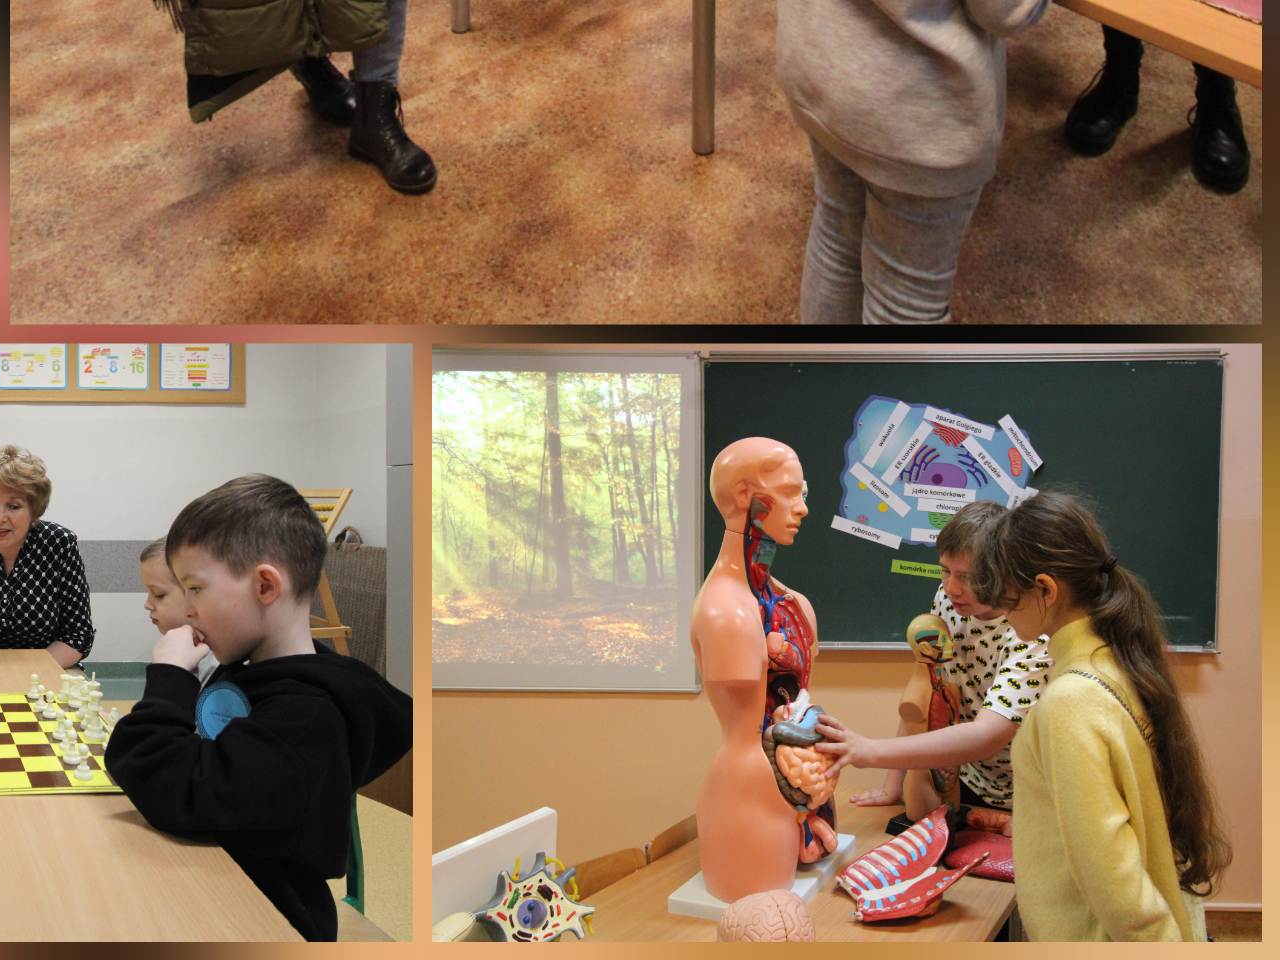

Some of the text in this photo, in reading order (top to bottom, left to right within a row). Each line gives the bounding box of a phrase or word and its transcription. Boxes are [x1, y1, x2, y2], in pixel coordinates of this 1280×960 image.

[1, 359, 10, 372] 8
[26, 359, 35, 372] 2
[51, 359, 61, 372] 6
[83, 360, 93, 373] 2
[109, 360, 118, 373] 8
[129, 361, 145, 373] 16
[935, 414, 982, 434] aparat Golgiego
[894, 438, 920, 470] ER szorstkie
[1008, 427, 1039, 468] mitochondrium
[977, 452, 1001, 479] ER gładkie
[869, 480, 890, 499] lizosom
[911, 487, 966, 499] jądro komórkowe
[851, 525, 881, 540] rybosomy
[899, 564, 927, 573] komórka
